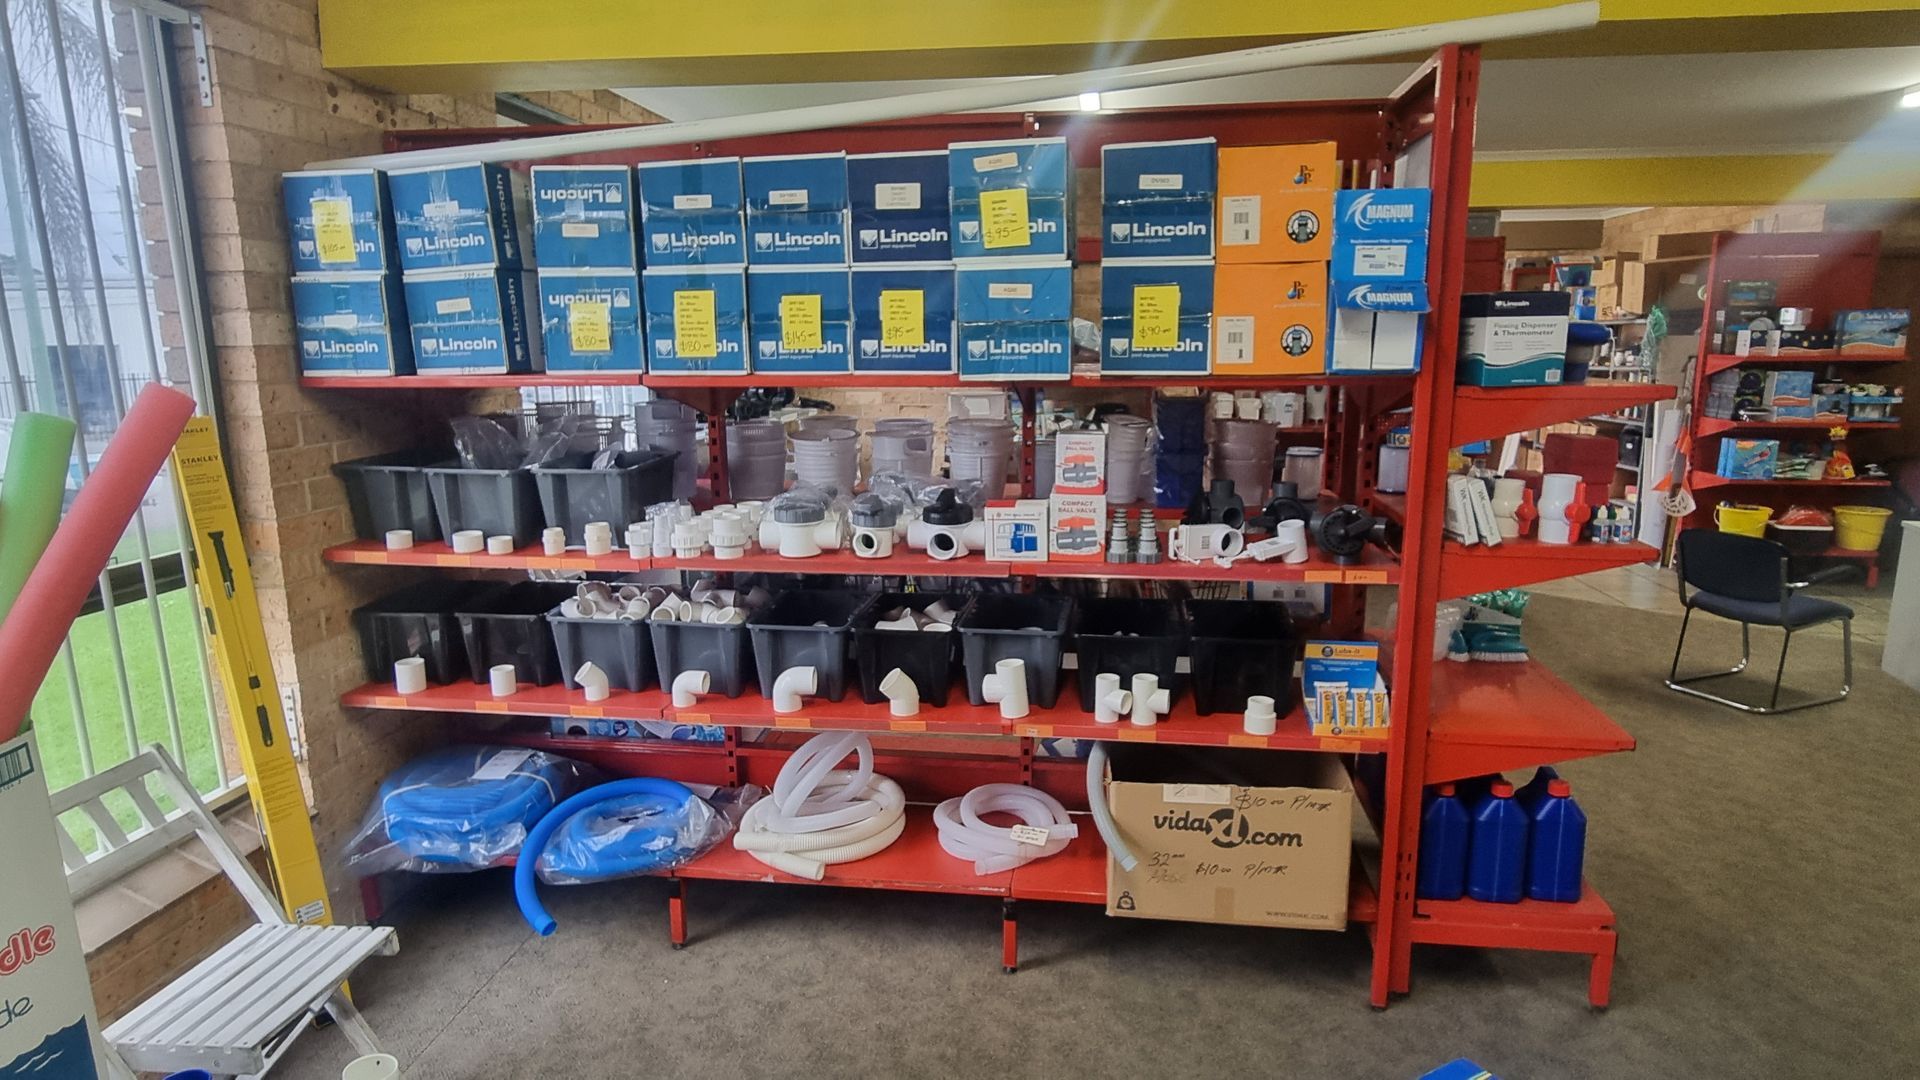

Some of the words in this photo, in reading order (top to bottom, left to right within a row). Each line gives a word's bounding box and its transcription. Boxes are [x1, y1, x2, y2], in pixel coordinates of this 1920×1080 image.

[540, 189, 604, 203] Lincoln
[1366, 204, 1415, 219] MAGNUM
[879, 228, 948, 243] Lincoln
[1132, 221, 1206, 237] Lincoln
[424, 233, 485, 251] Lincoln
[671, 231, 736, 246] Lincoln
[774, 231, 841, 246] Lincoln
[1366, 292, 1415, 305] MAGNUM
[1520, 321, 1558, 330] Dispenser
[321, 340, 379, 353] Lincoln
[439, 336, 498, 351] Lincoln
[989, 339, 1062, 353] Lincoln
[181, 454, 219, 465] STANLEY
